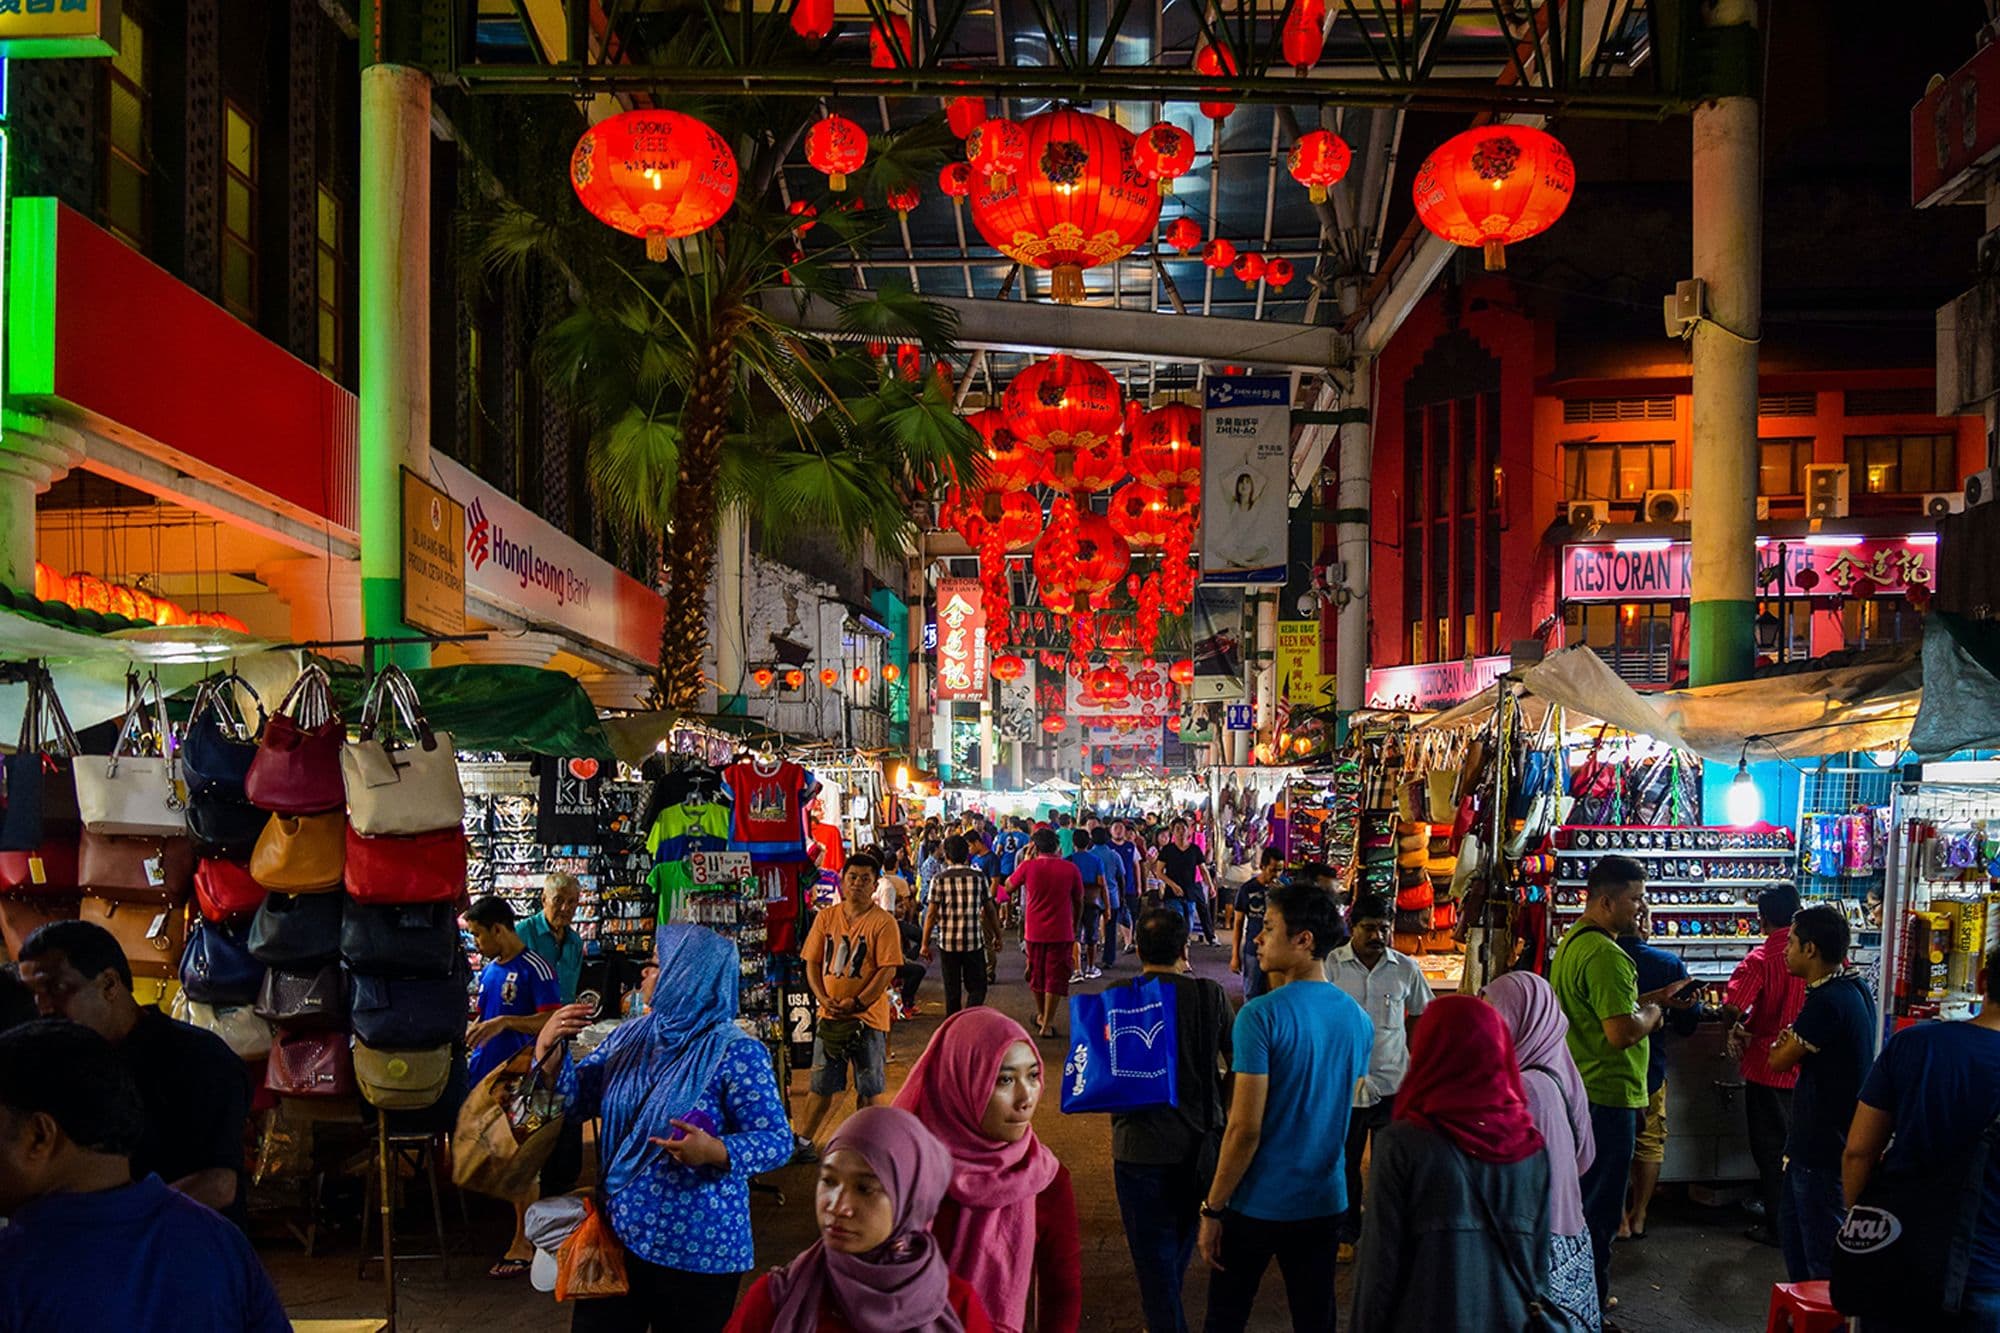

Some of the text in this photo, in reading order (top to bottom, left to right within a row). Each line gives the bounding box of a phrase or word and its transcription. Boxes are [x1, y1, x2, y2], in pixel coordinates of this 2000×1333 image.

[1215, 426, 1257, 435] ZHEN-AO
[941, 577, 979, 586] RESTORA
[1573, 550, 1672, 592] RESTORAN
[566, 567, 592, 611] Bank
[557, 756, 567, 780] I
[555, 779, 595, 806] KL
[742, 855, 749, 864] 7
[695, 866, 707, 883] 3
[730, 865, 752, 882] 15
[786, 992, 811, 1007] USA
[788, 1006, 814, 1043] 2
